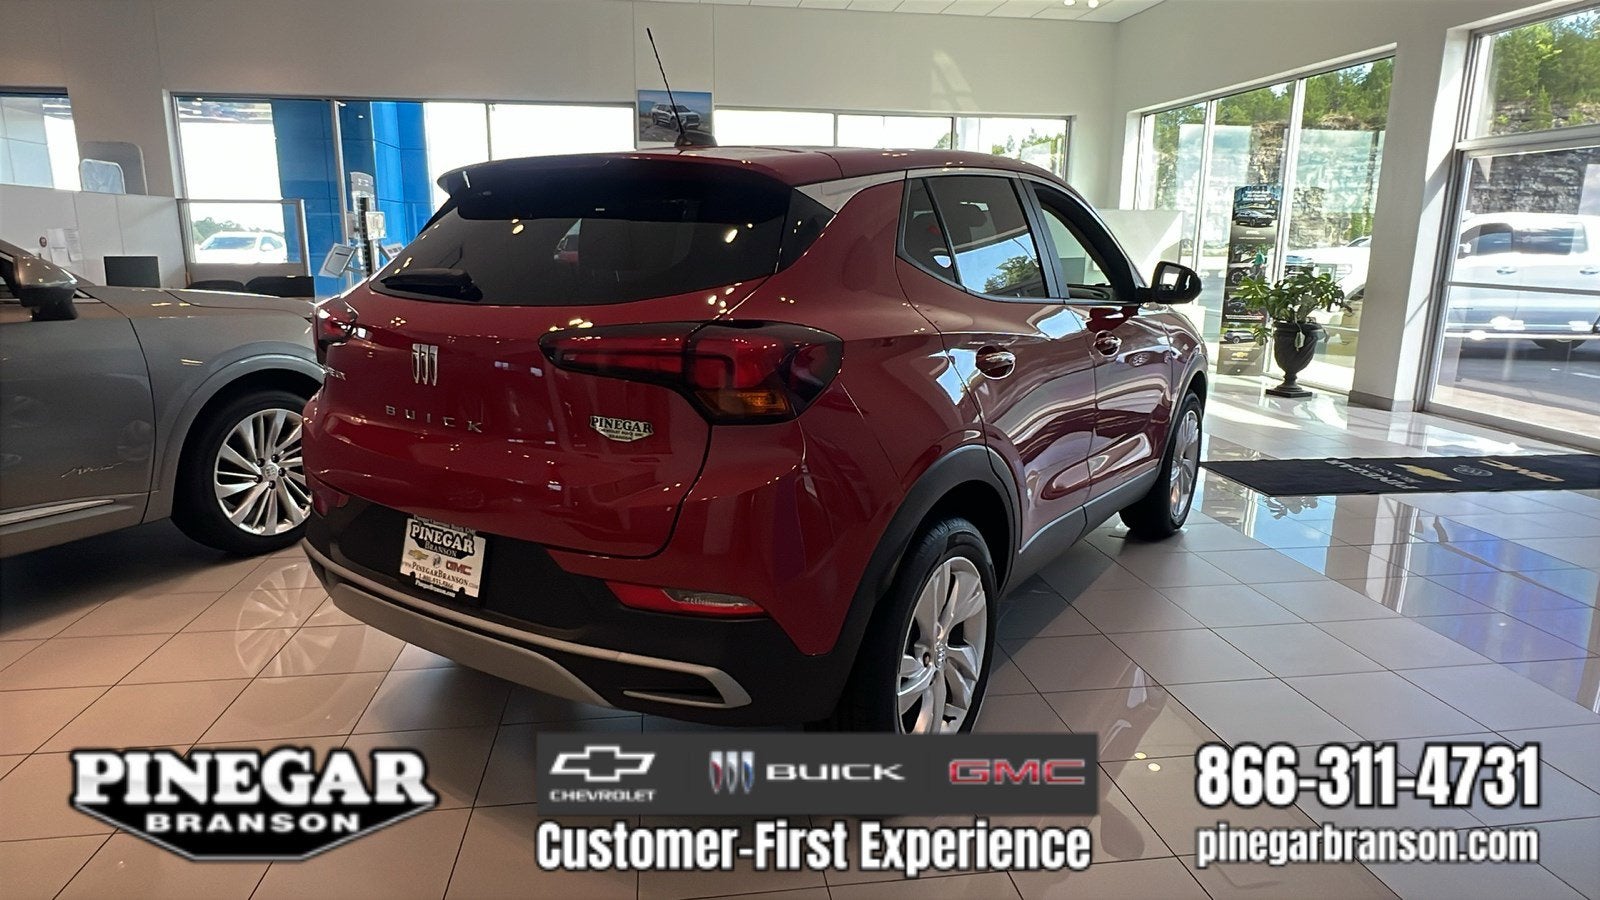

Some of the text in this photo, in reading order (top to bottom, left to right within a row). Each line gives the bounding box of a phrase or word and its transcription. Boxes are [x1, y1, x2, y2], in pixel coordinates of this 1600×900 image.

[385, 405, 483, 433] BUICK
[591, 417, 653, 433] PINEGAR
[411, 524, 474, 554] PINEGAR
[425, 540, 458, 557] BRANSON
[446, 560, 472, 576] GMC
